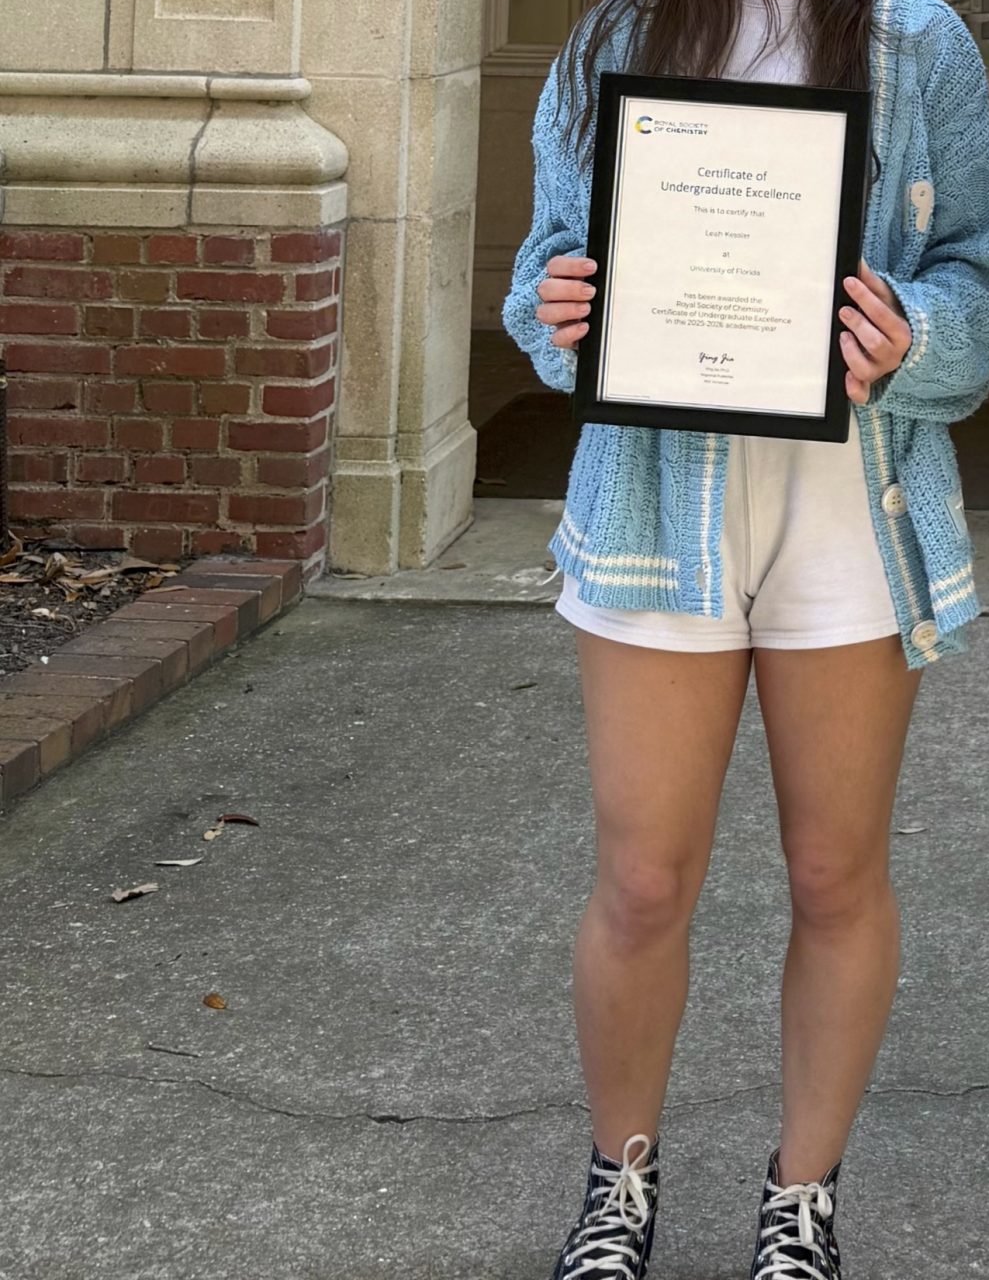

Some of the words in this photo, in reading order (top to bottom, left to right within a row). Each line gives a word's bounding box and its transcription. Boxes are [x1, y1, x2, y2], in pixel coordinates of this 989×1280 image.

[666, 127, 708, 135] CHEMISTRY
[697, 167, 753, 181] Certificate
[756, 171, 768, 182] of
[661, 181, 742, 197] Undergraduate
[746, 187, 802, 201] Excellence
[694, 205, 708, 214] This
[726, 208, 748, 218] certify
[690, 265, 725, 275] University
[736, 268, 761, 276] Florida
[684, 292, 697, 300] has
[698, 293, 716, 301] been
[750, 296, 763, 304] the
[676, 300, 696, 309] Royal
[697, 302, 722, 311] Society
[732, 305, 769, 315] Chemistry
[651, 307, 688, 316] Certificate
[698, 311, 753, 321] Undergraduate
[753, 315, 792, 324] Excellence
[726, 323, 760, 331] academic
